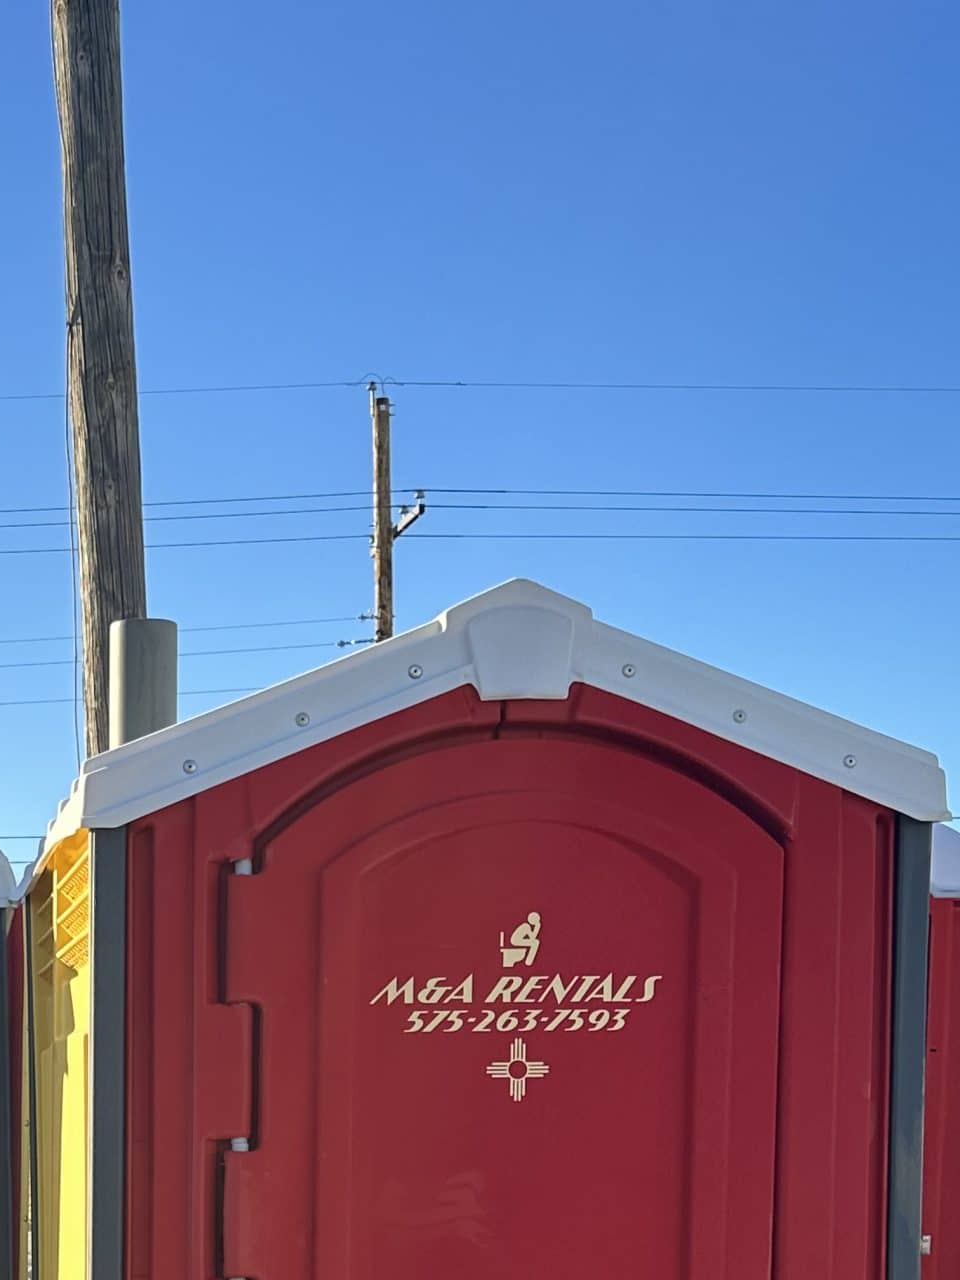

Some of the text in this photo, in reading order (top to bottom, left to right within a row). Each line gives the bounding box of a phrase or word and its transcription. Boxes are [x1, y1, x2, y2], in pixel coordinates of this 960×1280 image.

[369, 973, 662, 1005] M&A RENTALS
[404, 1009, 630, 1032] 575-263-7593
